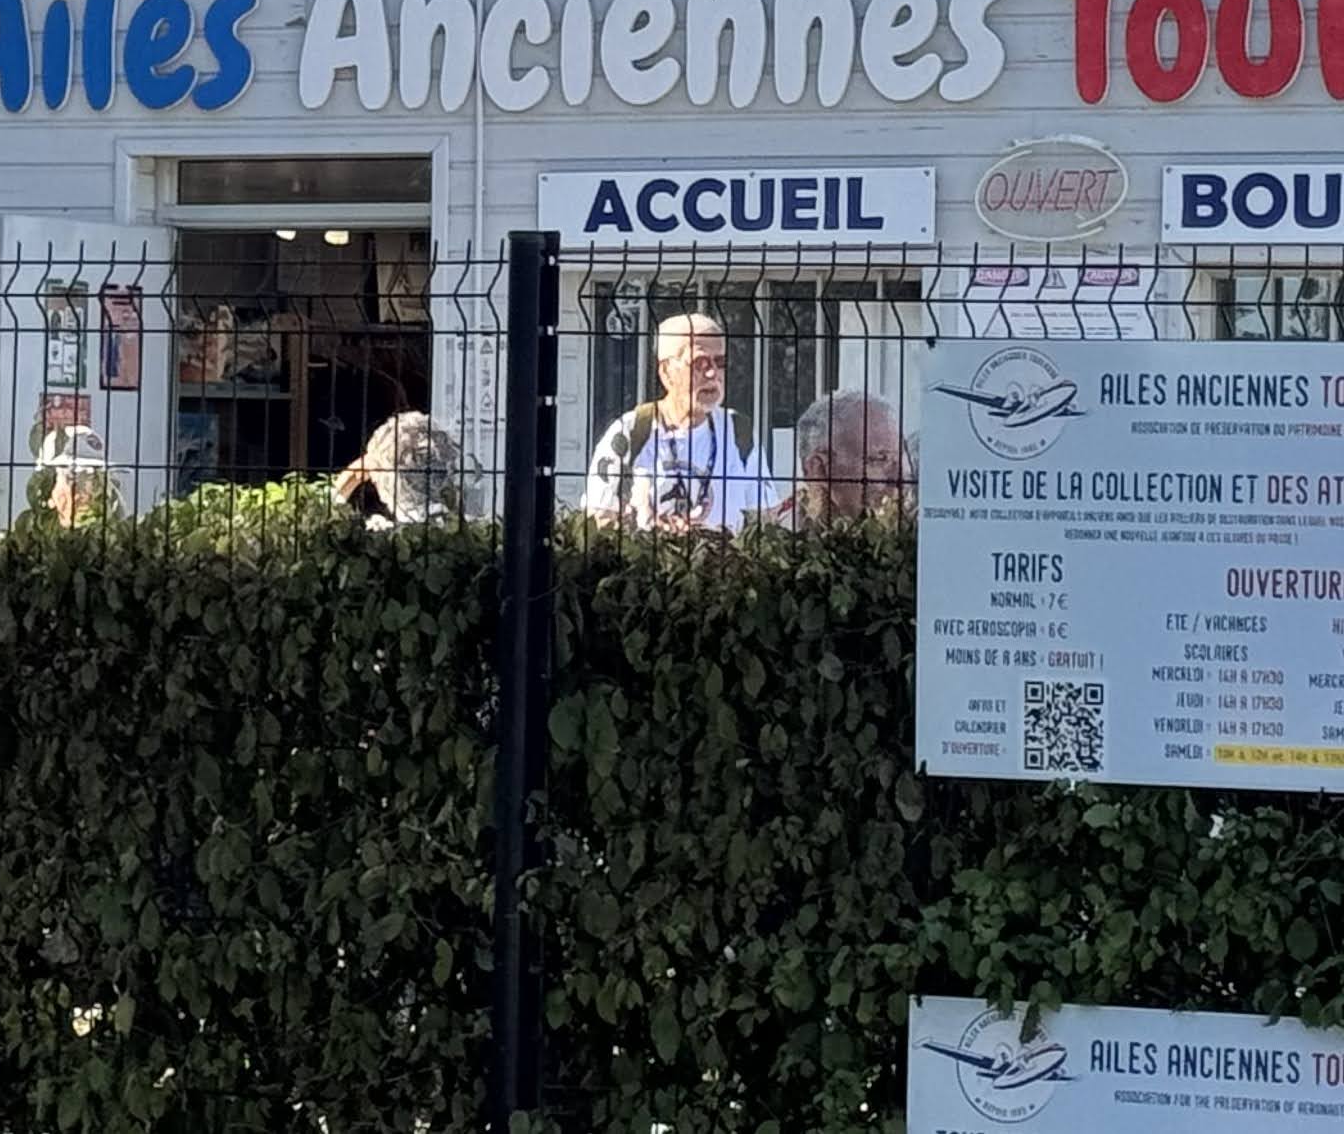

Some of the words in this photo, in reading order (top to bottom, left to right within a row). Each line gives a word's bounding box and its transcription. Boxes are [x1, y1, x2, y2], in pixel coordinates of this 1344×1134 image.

[583, 176, 885, 233] ACCUEIL
[984, 168, 1119, 212] OUVERT
[1100, 373, 1167, 406] AILES
[1176, 373, 1309, 408] ANCIENNES
[947, 469, 1013, 500] VISITE
[1022, 470, 1047, 500] DE
[1057, 471, 1083, 501] LA
[1092, 471, 1222, 503] COLLECTION
[1232, 474, 1259, 503] ET
[1267, 475, 1309, 505] DES
[992, 552, 1064, 583] TARIFS
[990, 592, 1036, 609] NORMAL
[934, 619, 965, 636] AVEC
[968, 620, 1037, 638] AEROSCOPIA
[1166, 613, 1188, 632] ETE
[1204, 615, 1268, 633] VACANCES
[946, 649, 981, 666] MOINS
[985, 650, 999, 666] DE
[1047, 651, 1097, 669] GRATUIT
[1184, 644, 1248, 662] SCOLAIRES
[1090, 1039, 1158, 1076] AILES
[1167, 1044, 1302, 1084] ANCIENNES
